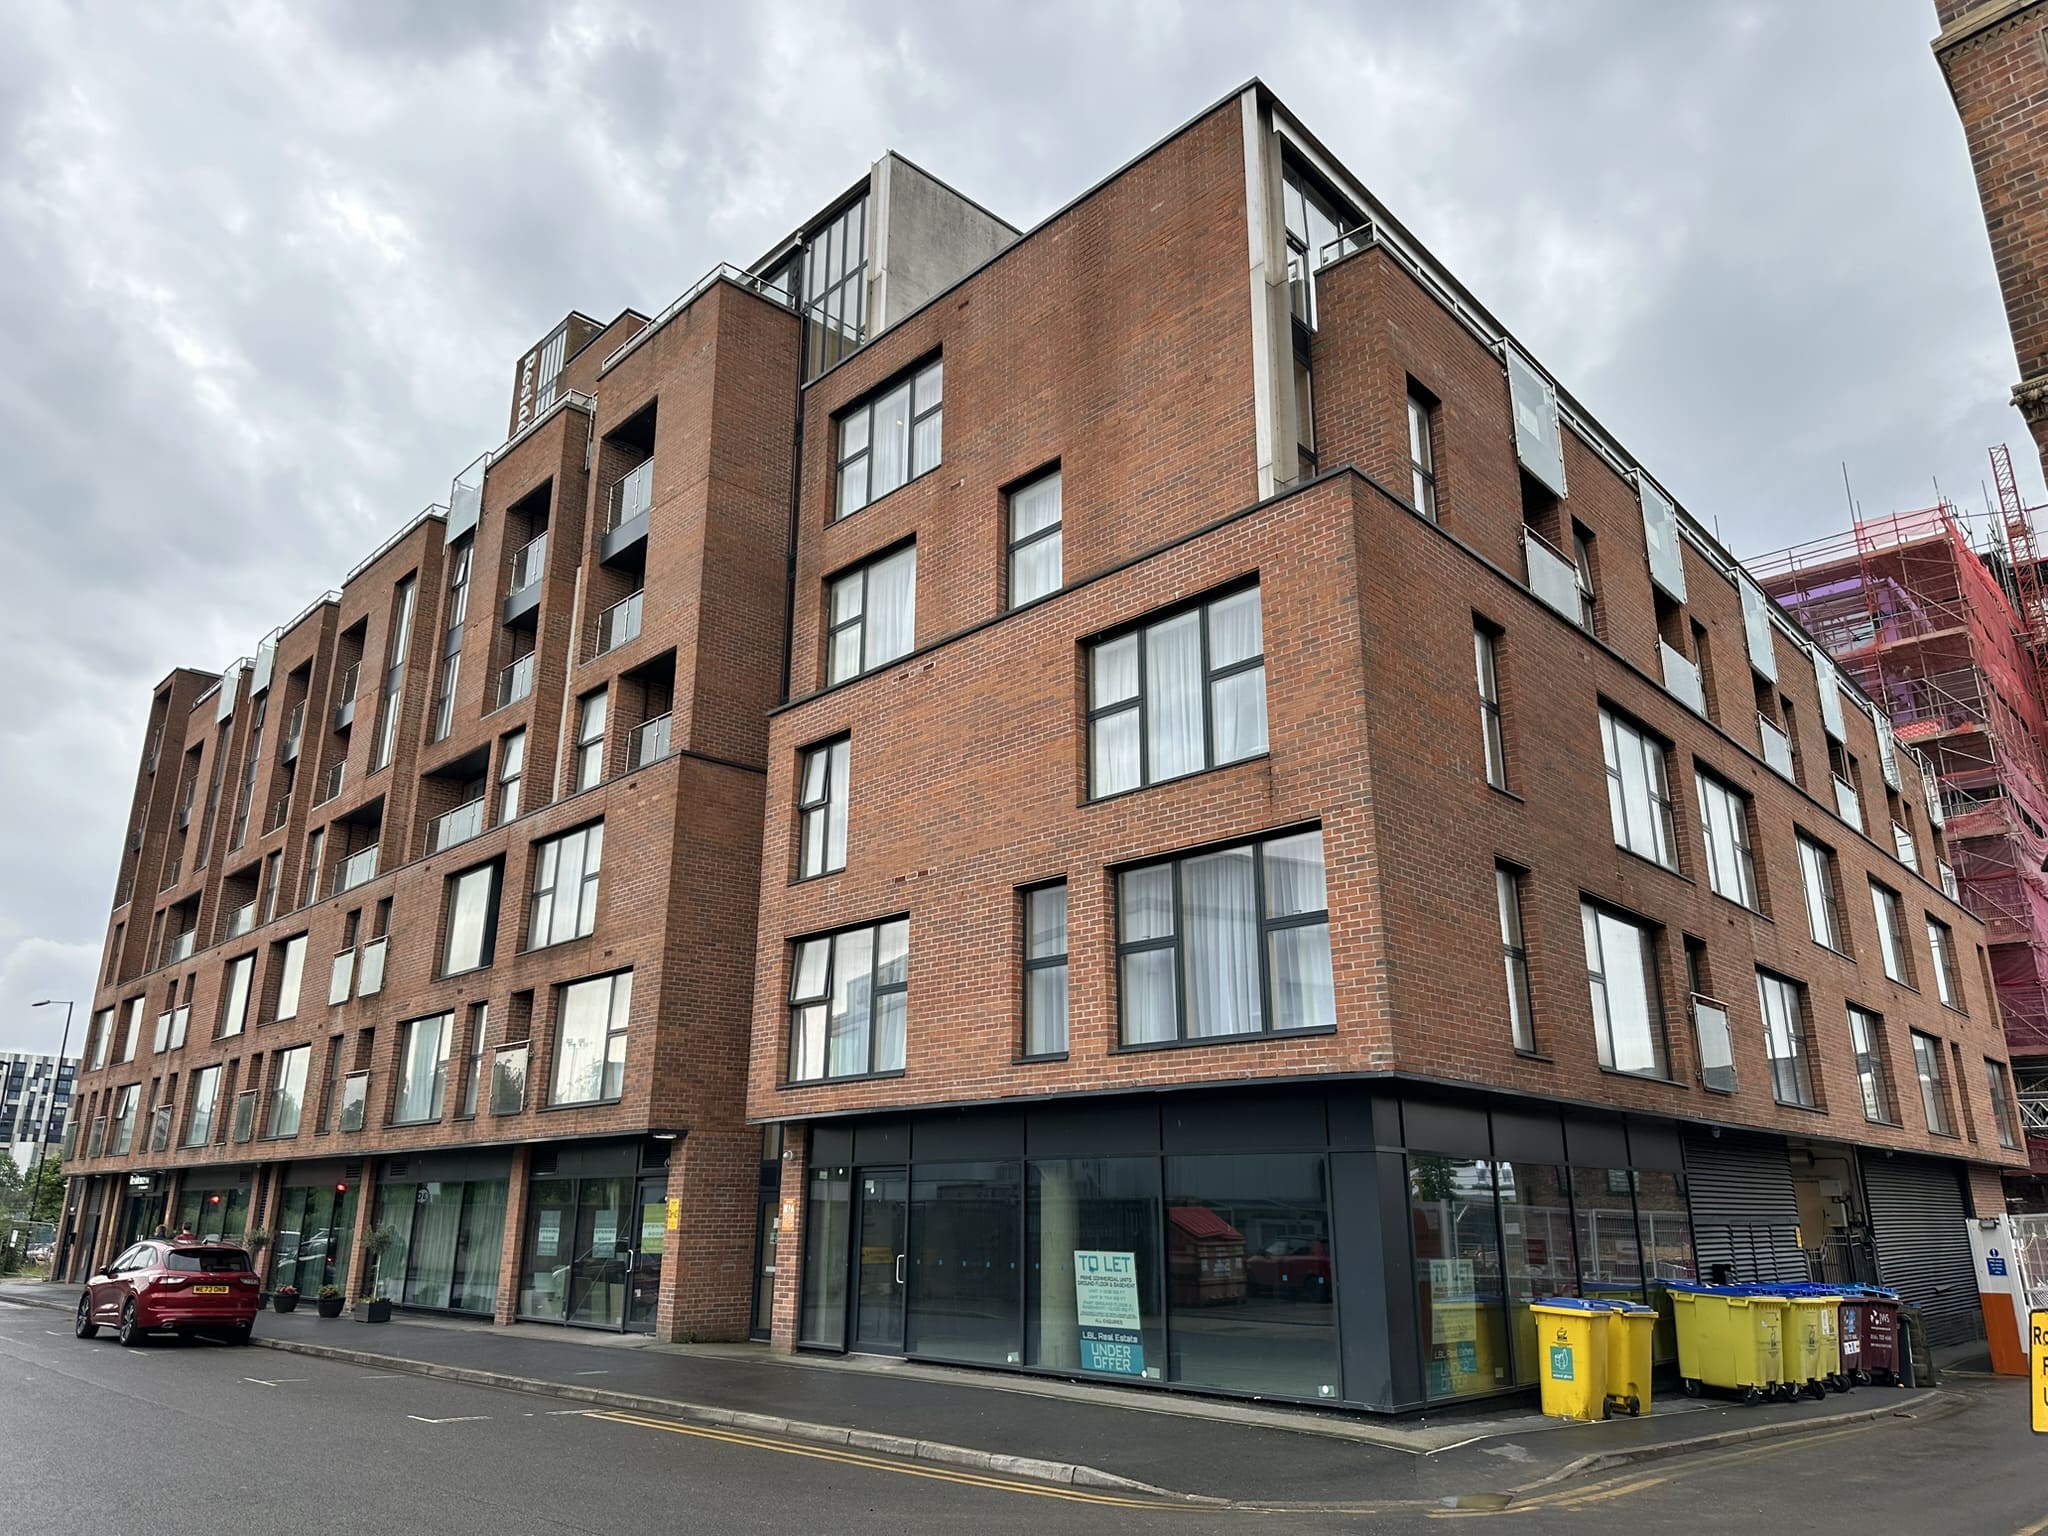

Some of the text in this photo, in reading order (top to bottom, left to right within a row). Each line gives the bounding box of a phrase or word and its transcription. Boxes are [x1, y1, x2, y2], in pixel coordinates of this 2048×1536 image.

[1078, 1255, 1130, 1273] TO LET
[1432, 1262, 1471, 1283] TO LET
[1098, 1332, 1114, 1341] Real
[1115, 1333, 1138, 1344] Estate
[1091, 1343, 1131, 1359] UNDER
[1093, 1355, 1132, 1372] OFFER
